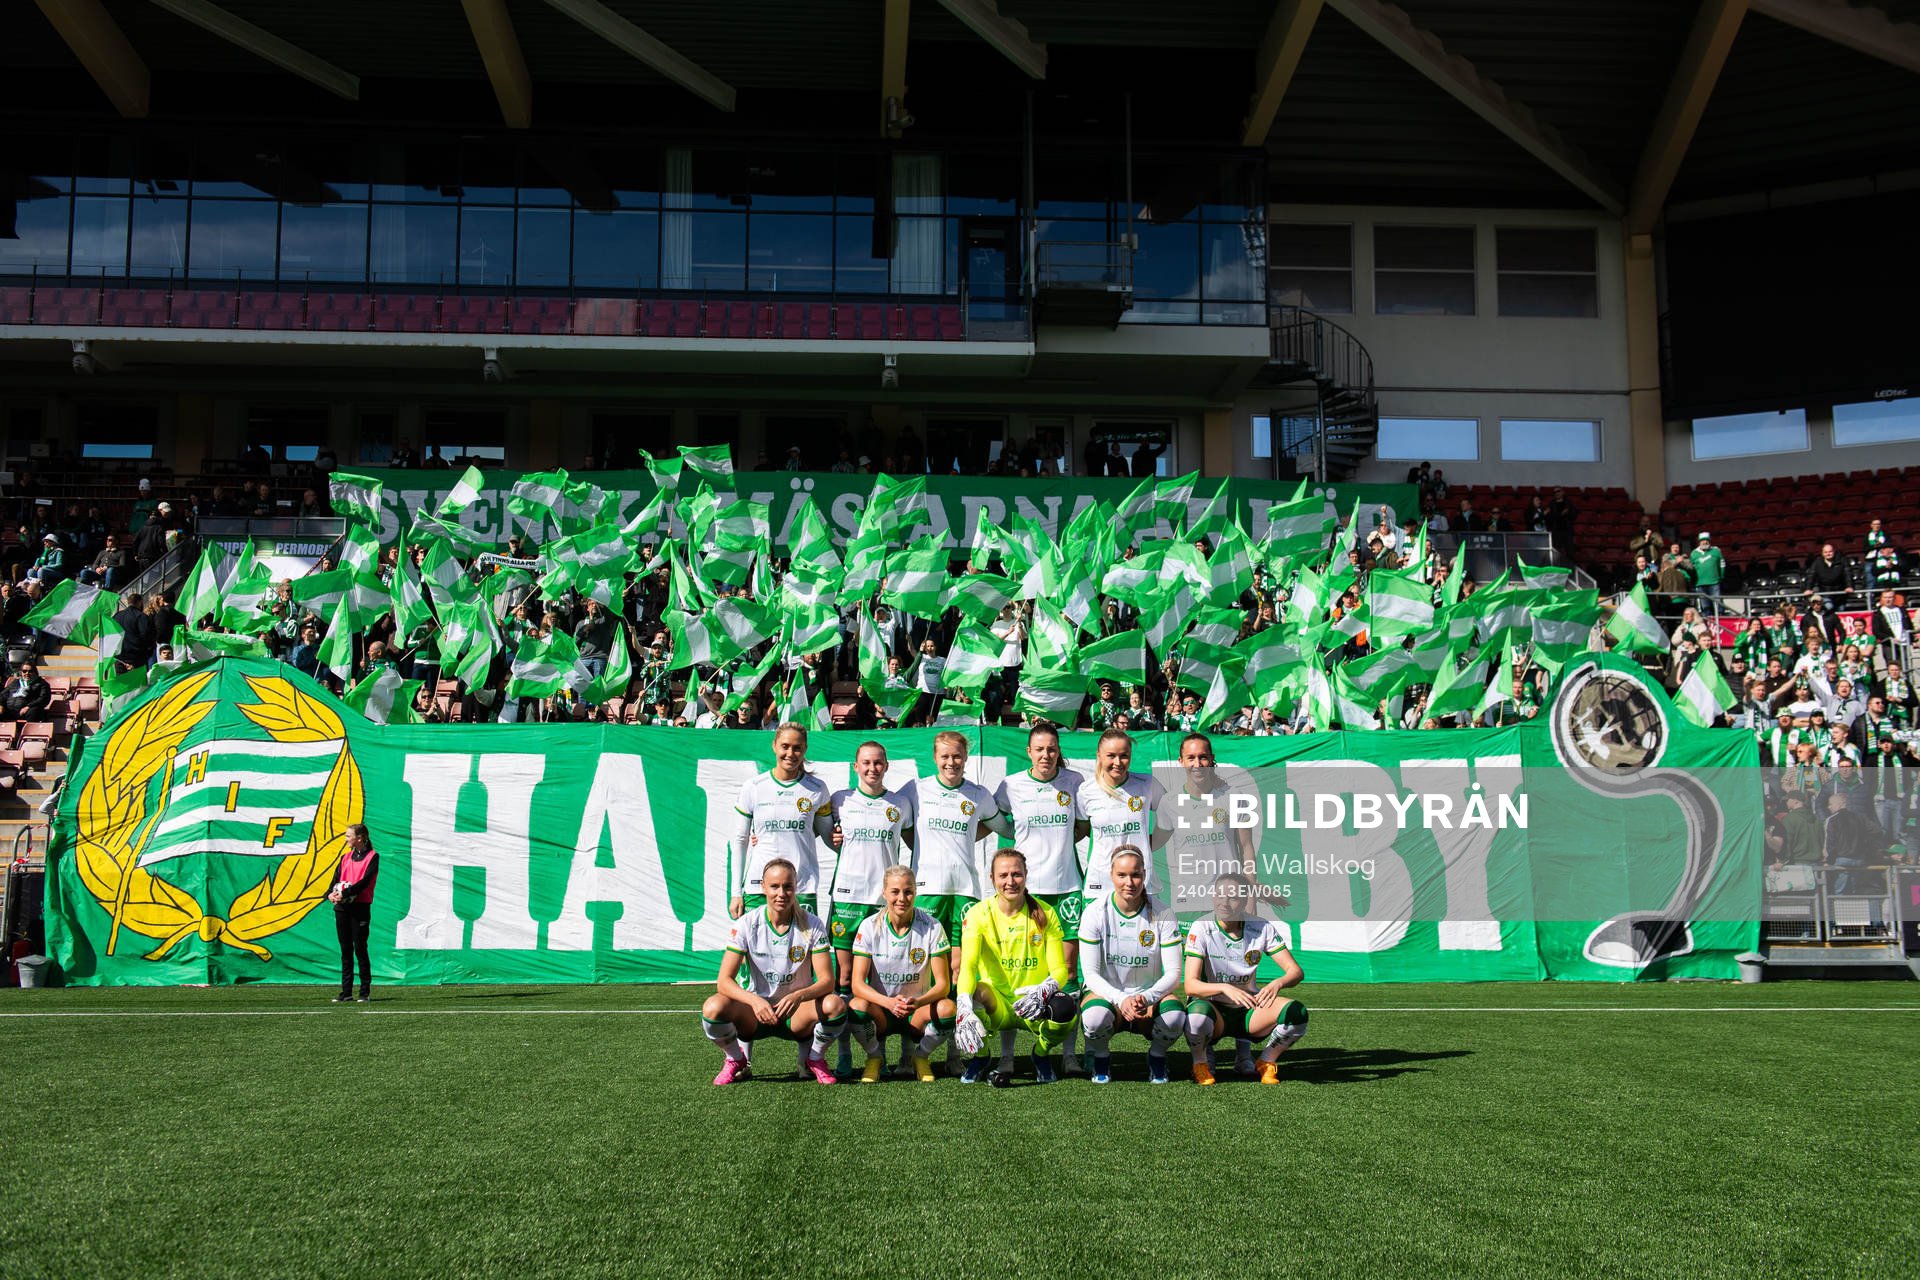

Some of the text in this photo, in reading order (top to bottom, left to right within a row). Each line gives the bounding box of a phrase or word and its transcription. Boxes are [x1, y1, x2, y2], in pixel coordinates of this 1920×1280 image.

[765, 819, 806, 830] PROJOB
[928, 817, 969, 832] PROJOB
[1028, 814, 1068, 825] PROJOB
[1101, 821, 1141, 834] PROJOB
[854, 828, 894, 840] PROJOB
[1185, 831, 1225, 844] PROJOB
[1106, 953, 1149, 965] PROJOB
[880, 972, 920, 982] PROJOB
